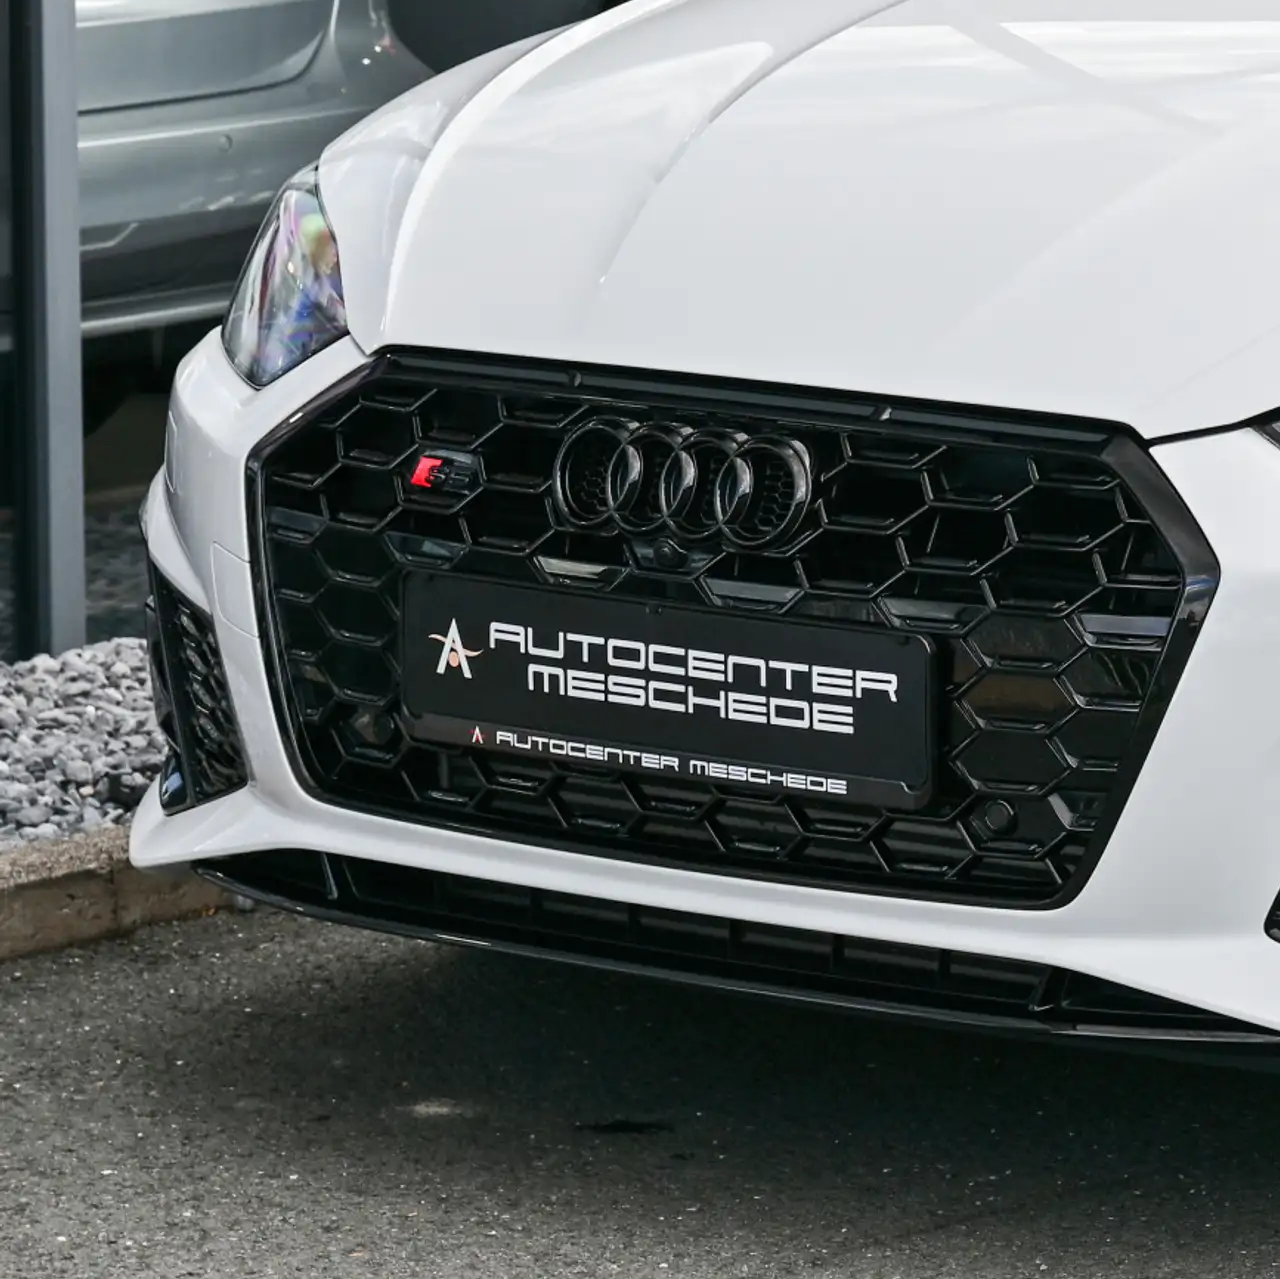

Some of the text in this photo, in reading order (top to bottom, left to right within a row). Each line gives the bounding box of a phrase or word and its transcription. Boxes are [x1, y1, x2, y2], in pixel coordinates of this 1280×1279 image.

[489, 621, 898, 702] AUTOCENTER
[527, 662, 855, 735] MESCHEDE
[495, 730, 679, 773] AUTOCENTER
[689, 759, 848, 795] MESCHEDE
